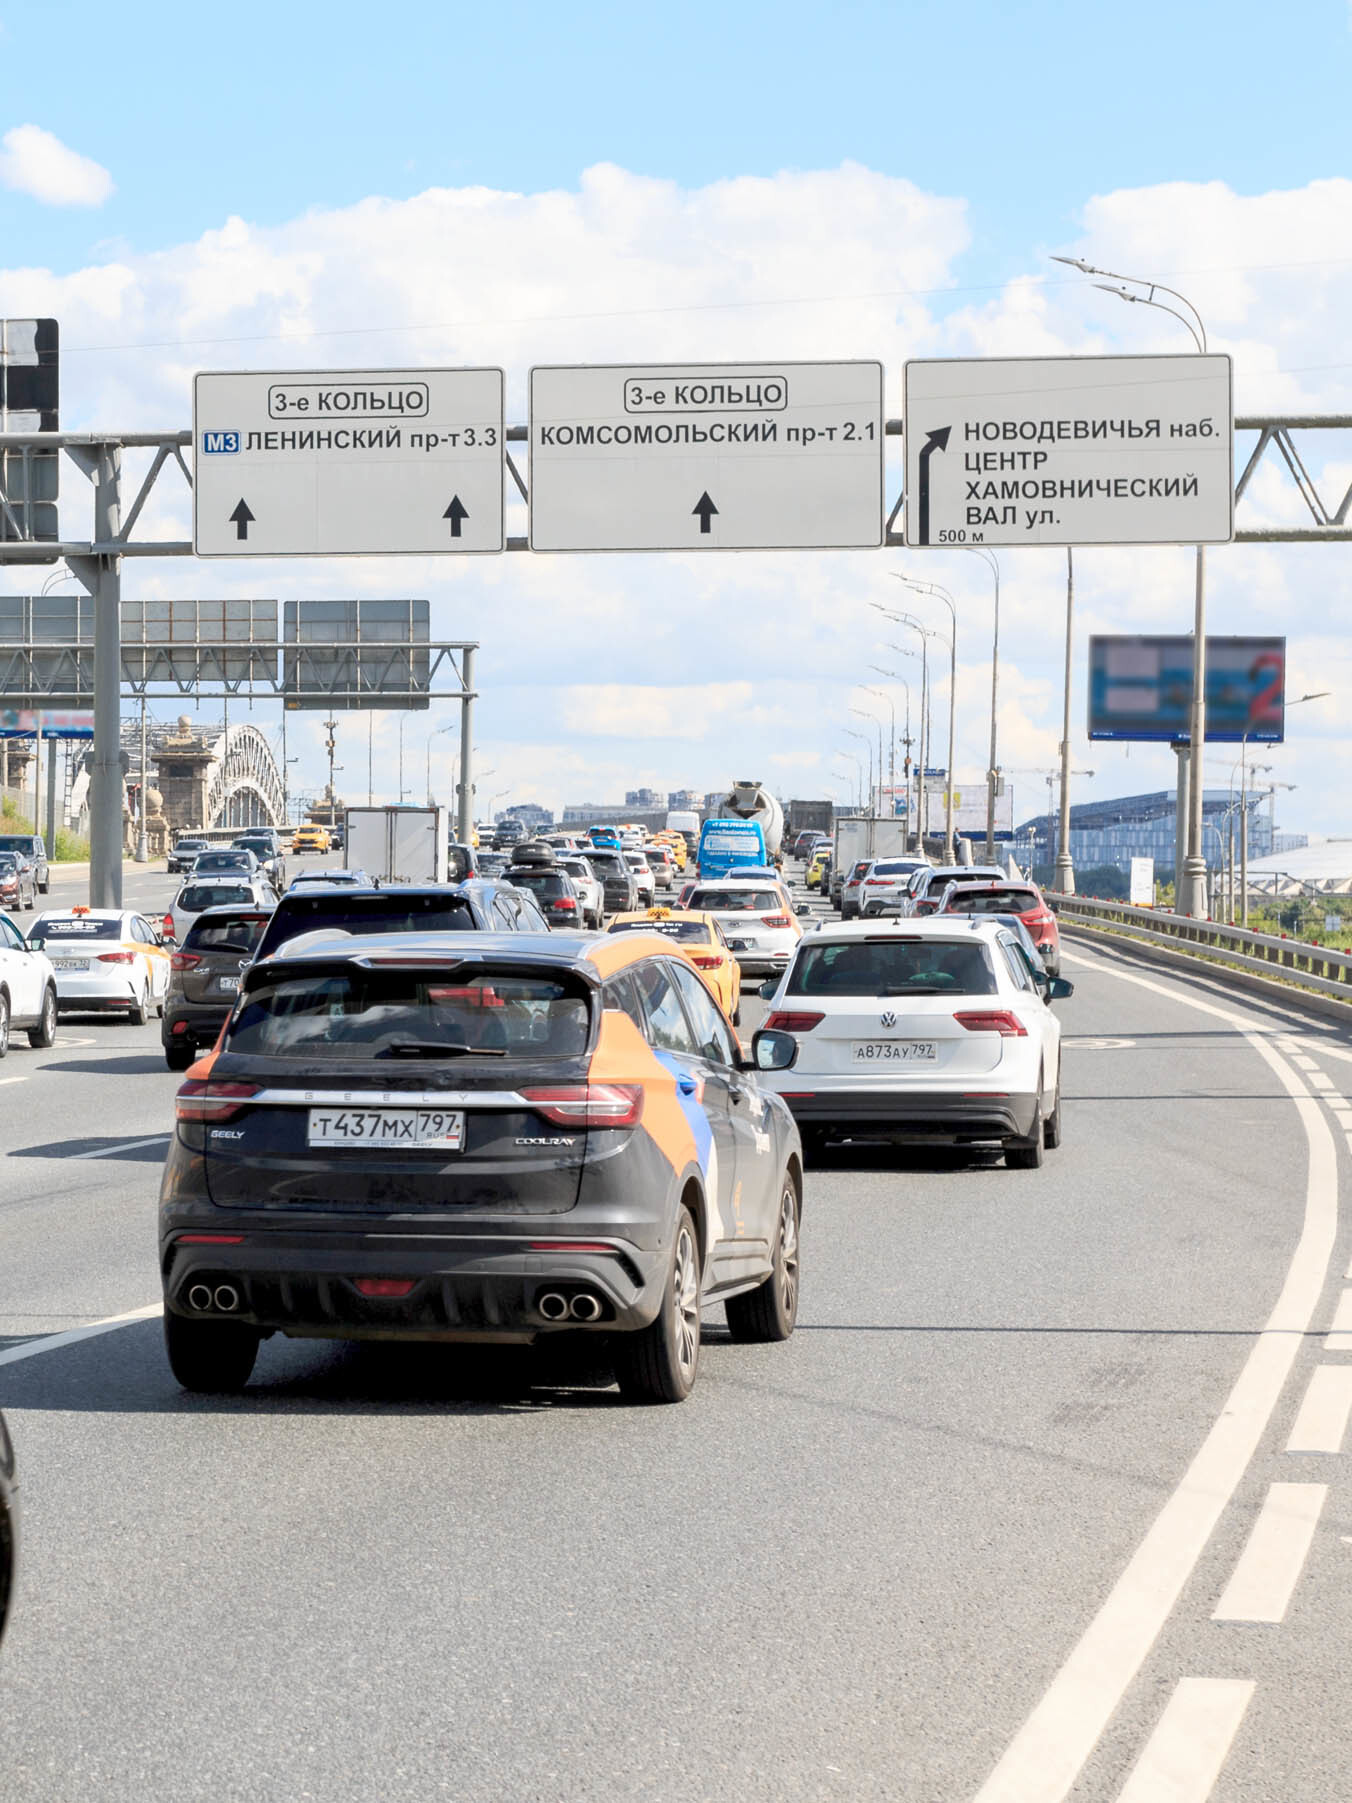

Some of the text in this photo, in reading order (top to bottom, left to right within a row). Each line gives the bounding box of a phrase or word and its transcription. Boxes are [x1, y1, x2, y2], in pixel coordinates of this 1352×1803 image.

[274, 391, 424, 414] 3-е КОЛЬЦО
[630, 384, 783, 407] 3-е КОЛЬЦО
[206, 432, 238, 452] М3
[245, 425, 401, 451] ЛЕНИНСКИЙ
[541, 419, 778, 446] КОМСОМОЛЬСКИЙ
[786, 427, 838, 447] пр-т
[964, 417, 1221, 444] НОВОДЕВИЧЬЯ наб.
[964, 451, 1048, 475] ЦЕНТР
[965, 473, 1199, 501] ХАМОВНИЧЕСКИЙ
[966, 505, 1061, 530] ВАЛ ул.
[938, 529, 985, 543] 500 м
[210, 1129, 246, 1139] GEELY
[515, 1137, 576, 1146] COOLRAY
